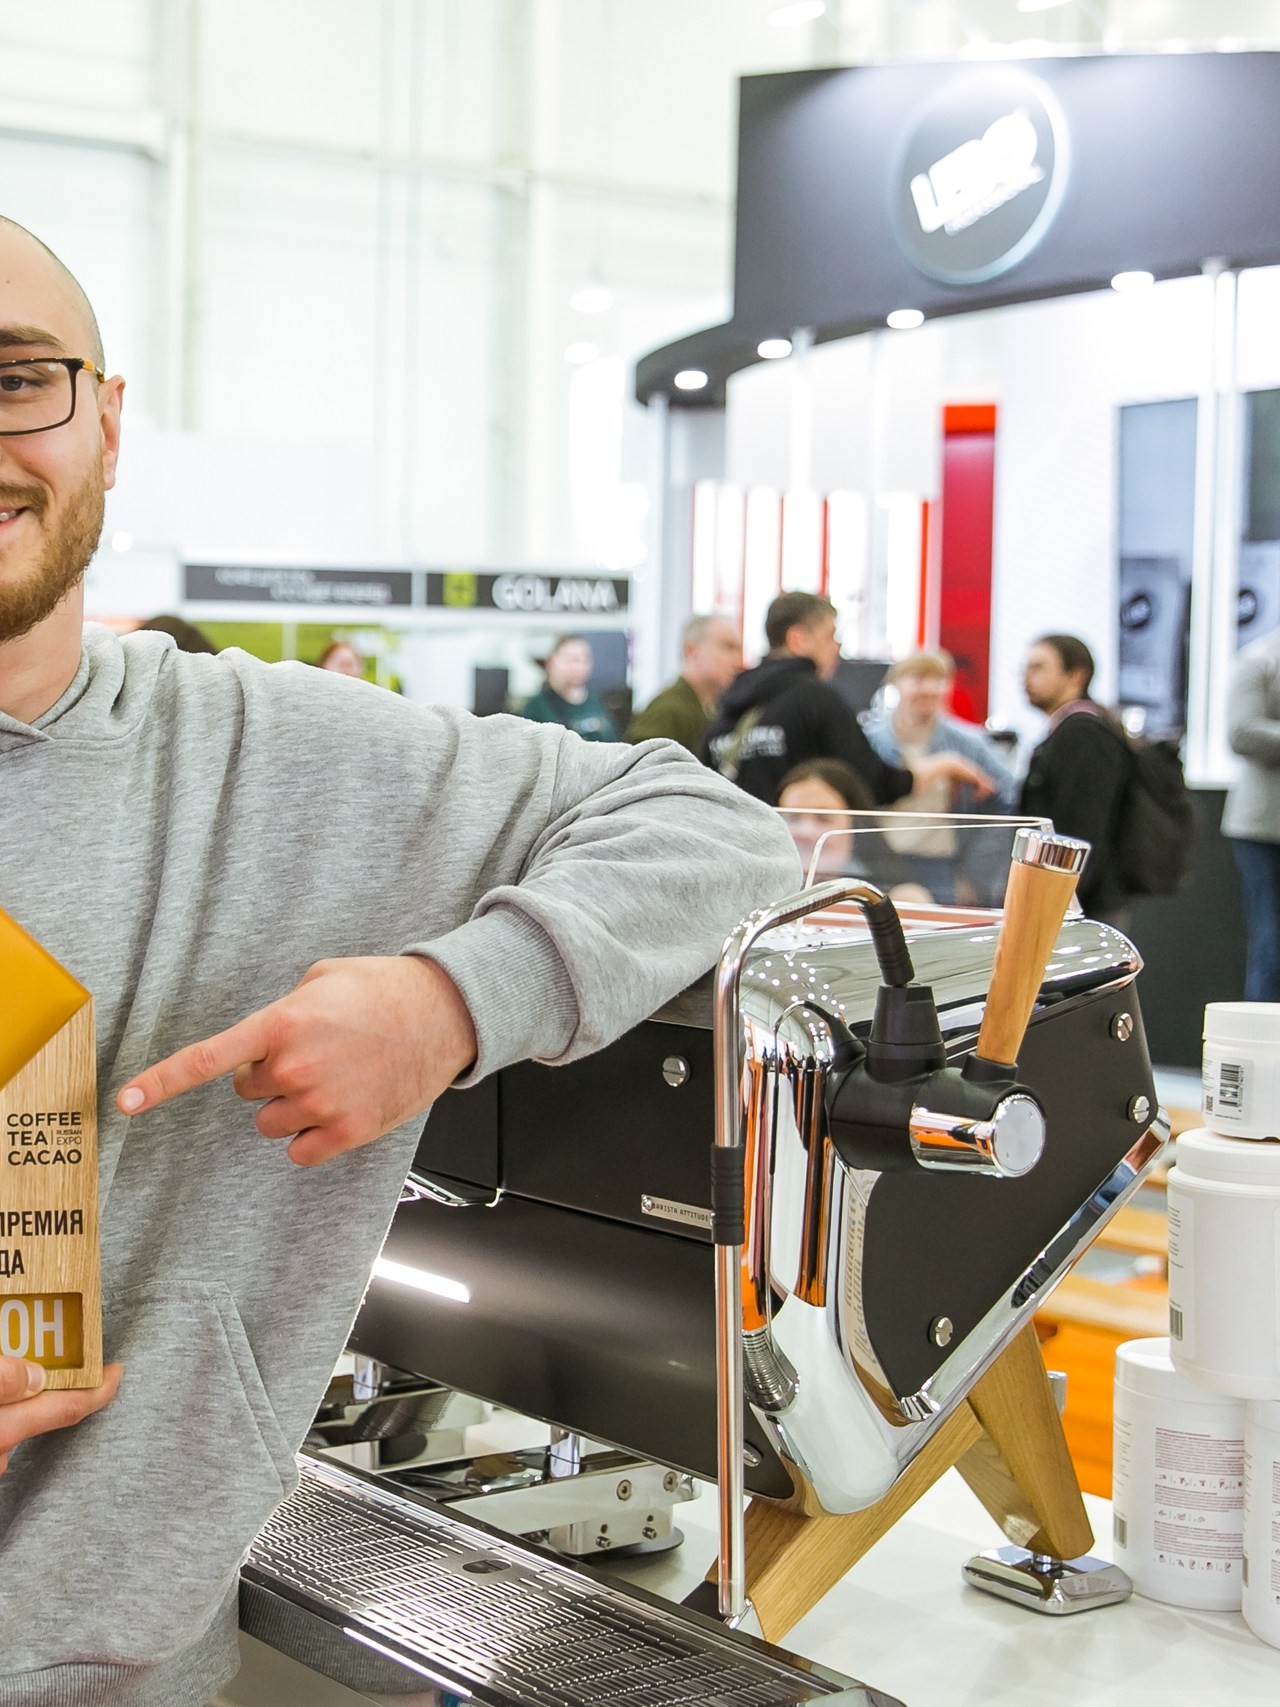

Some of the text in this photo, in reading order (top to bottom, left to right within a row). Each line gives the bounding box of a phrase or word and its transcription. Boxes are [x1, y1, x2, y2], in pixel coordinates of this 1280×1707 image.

[7, 1111, 82, 1127] COFFEE
[7, 1130, 48, 1146] TEA
[56, 1136, 82, 1146] EXPO
[7, 1149, 82, 1166] CACAO
[680, 1208, 709, 1222] ATTITUDE
